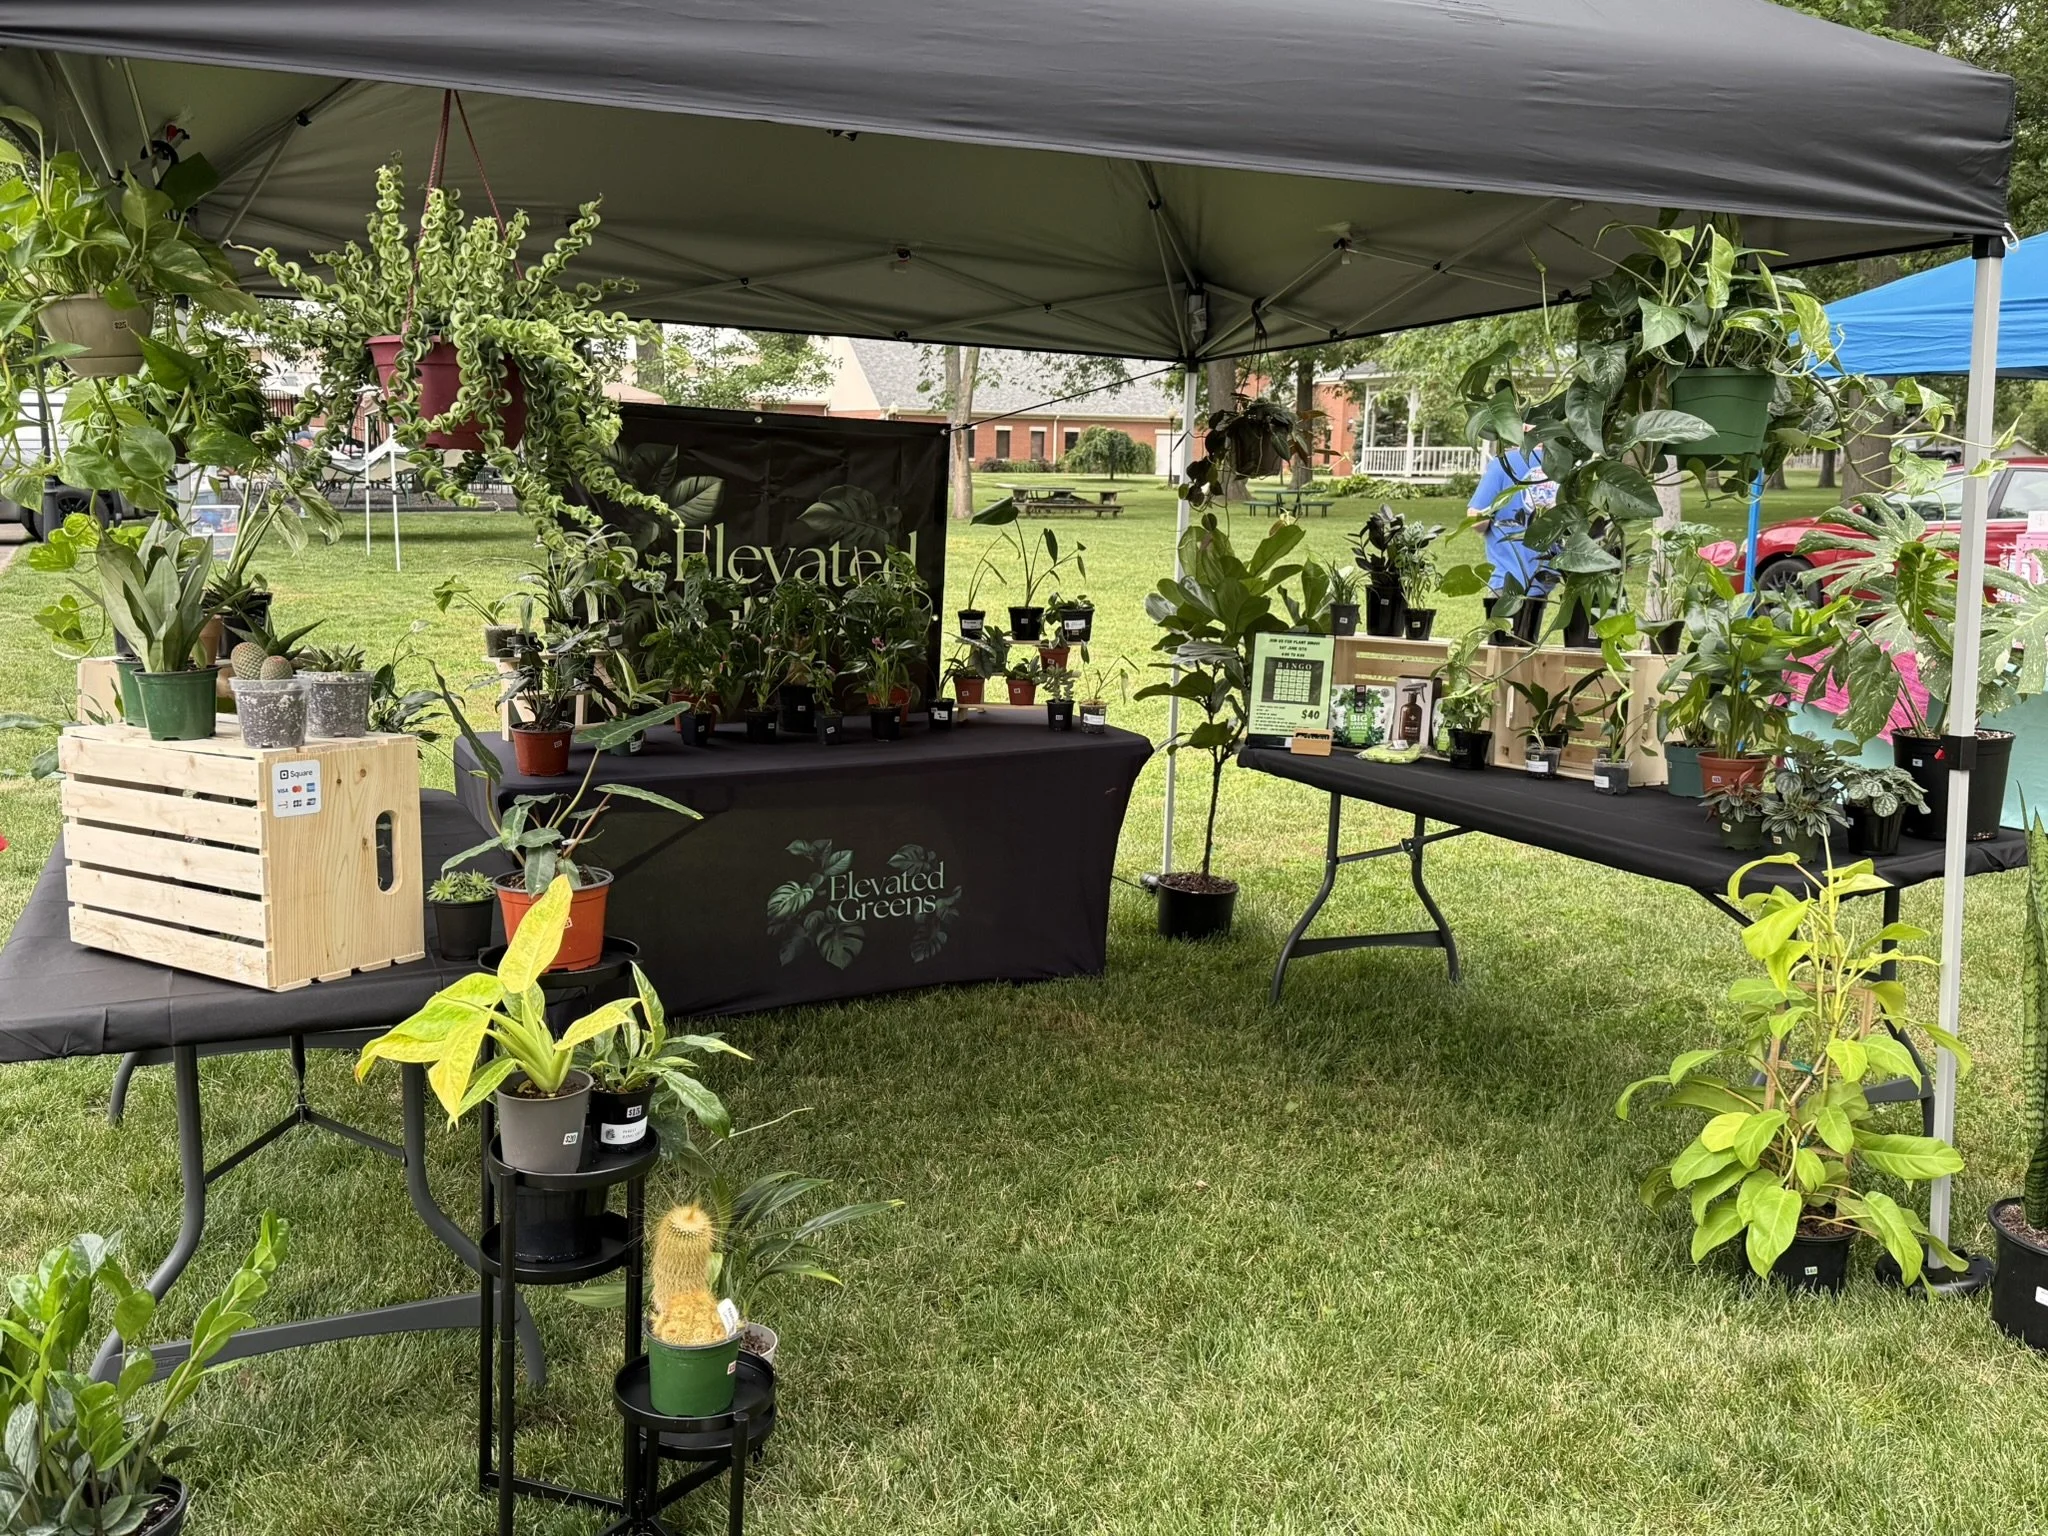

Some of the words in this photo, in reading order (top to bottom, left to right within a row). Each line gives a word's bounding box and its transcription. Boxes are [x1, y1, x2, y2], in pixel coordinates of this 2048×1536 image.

[1277, 661, 1312, 671] BINGO
[1301, 709, 1320, 720] $40
[1350, 714, 1367, 722] BIG
[290, 770, 313, 778] Square
[830, 861, 944, 901] Elevated
[837, 893, 936, 923] Greens
[628, 1107, 641, 1117] $15
[565, 1135, 577, 1143] $20
